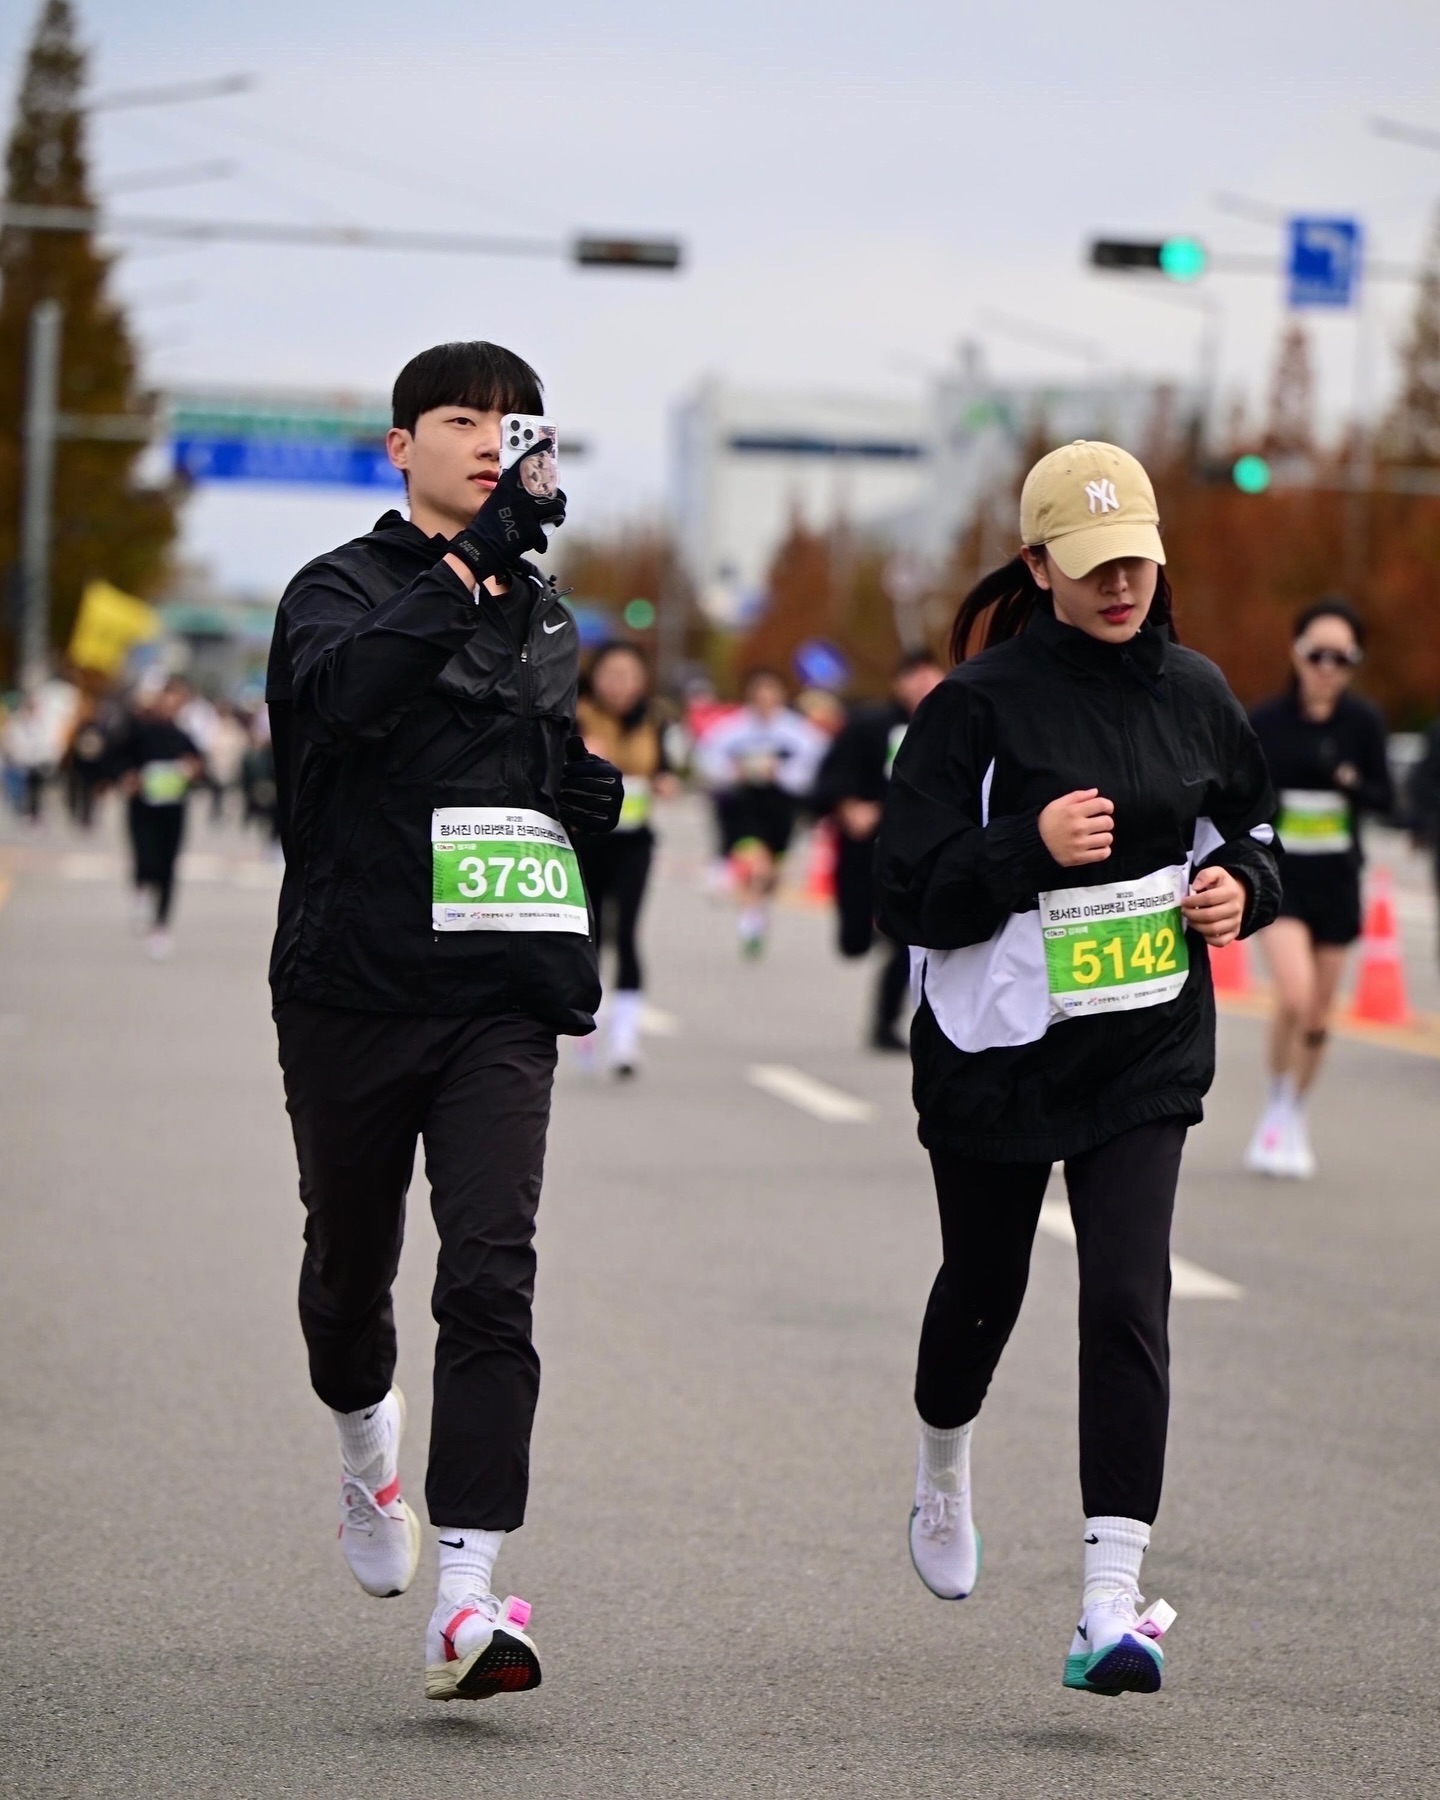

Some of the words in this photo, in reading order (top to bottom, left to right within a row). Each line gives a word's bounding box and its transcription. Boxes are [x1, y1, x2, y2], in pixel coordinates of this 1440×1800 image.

[1085, 478, 1120, 514] NY
[499, 507, 520, 541] BAC
[440, 824, 471, 836] 정서진
[474, 824, 514, 836] 아라뱃길
[457, 856, 568, 899] 3730
[1049, 907, 1081, 921] 정서진
[1084, 902, 1126, 917] 아라뱃길
[1046, 930, 1065, 938] 10km
[1072, 927, 1177, 984] 5142
